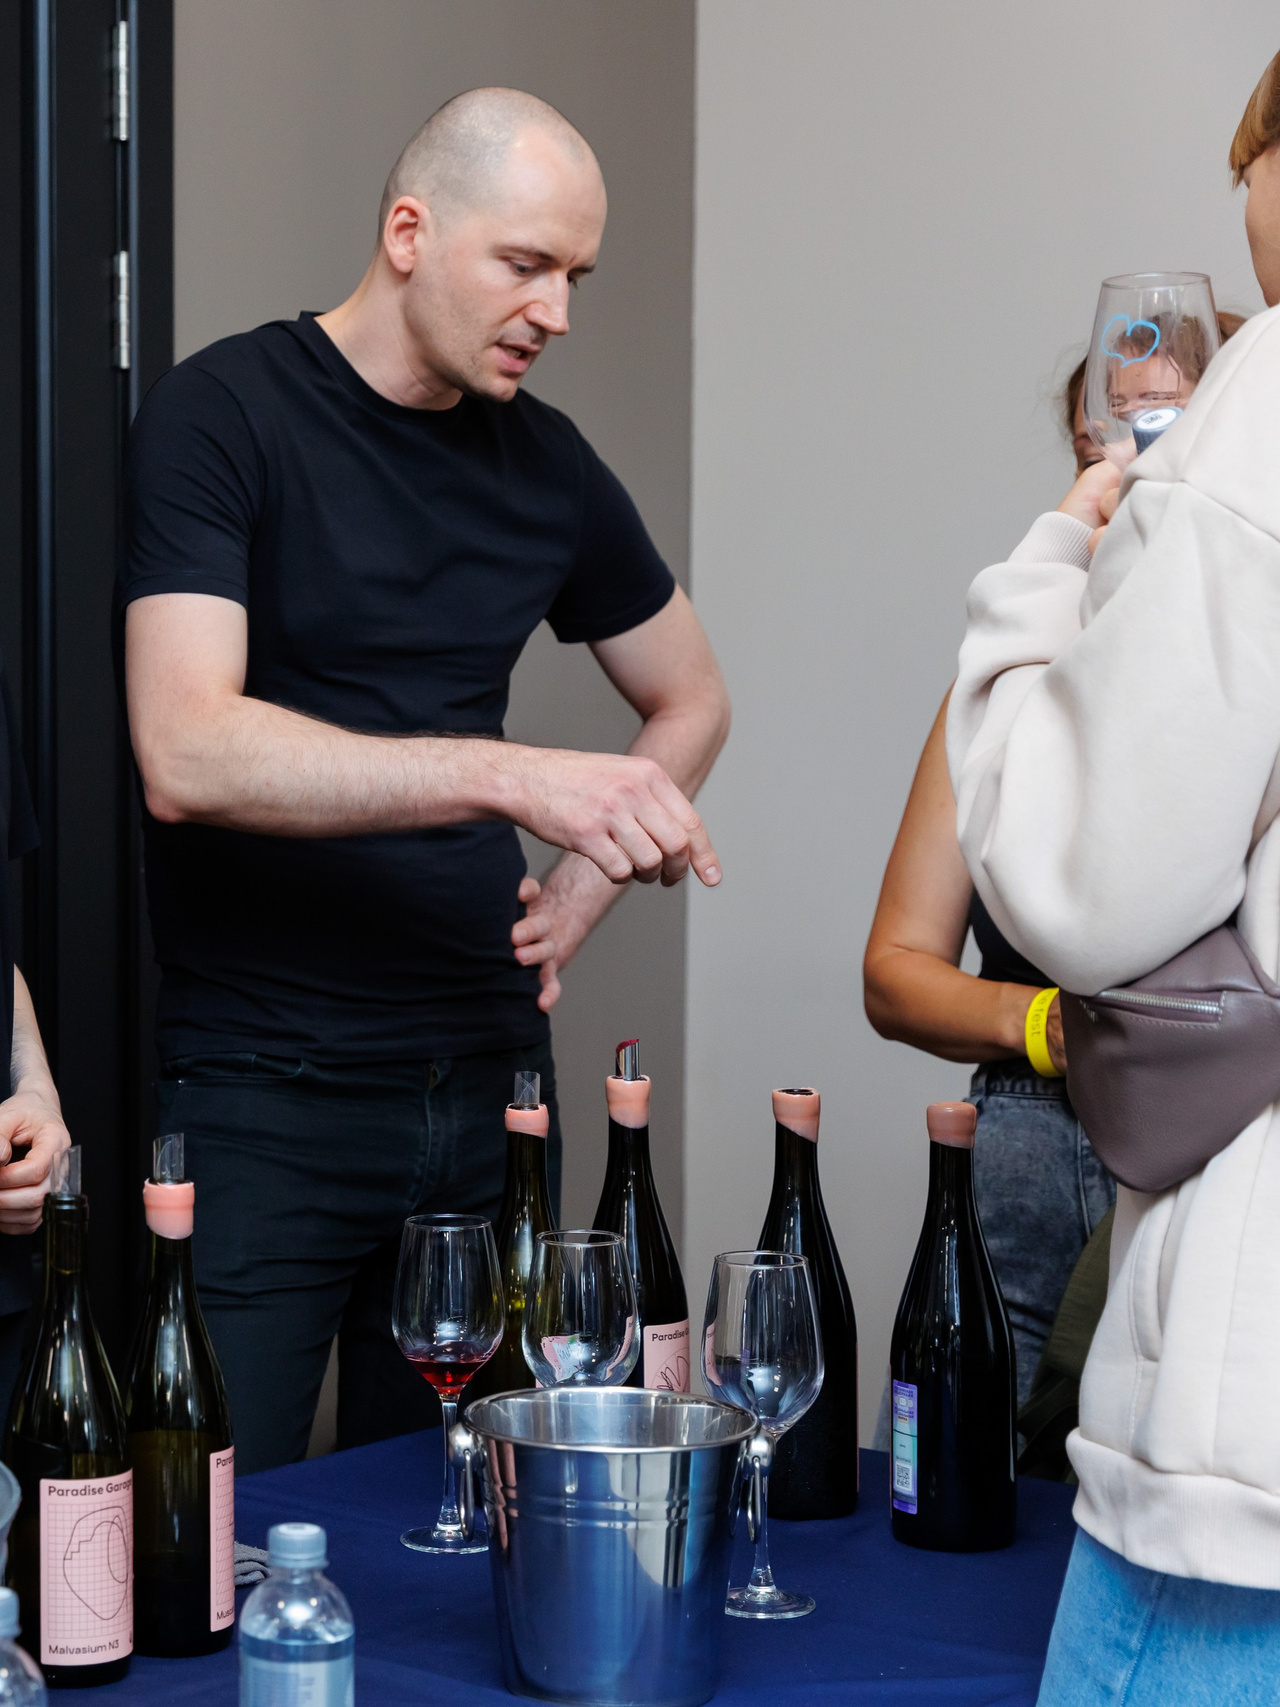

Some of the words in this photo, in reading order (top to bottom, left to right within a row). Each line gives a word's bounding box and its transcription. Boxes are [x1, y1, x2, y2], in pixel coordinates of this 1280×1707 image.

[651, 1329, 685, 1342] Paradise
[48, 1485, 104, 1498] Paradise
[105, 1479, 132, 1494] Garag
[48, 1642, 108, 1655] Malvasium
[108, 1639, 120, 1651] N3
